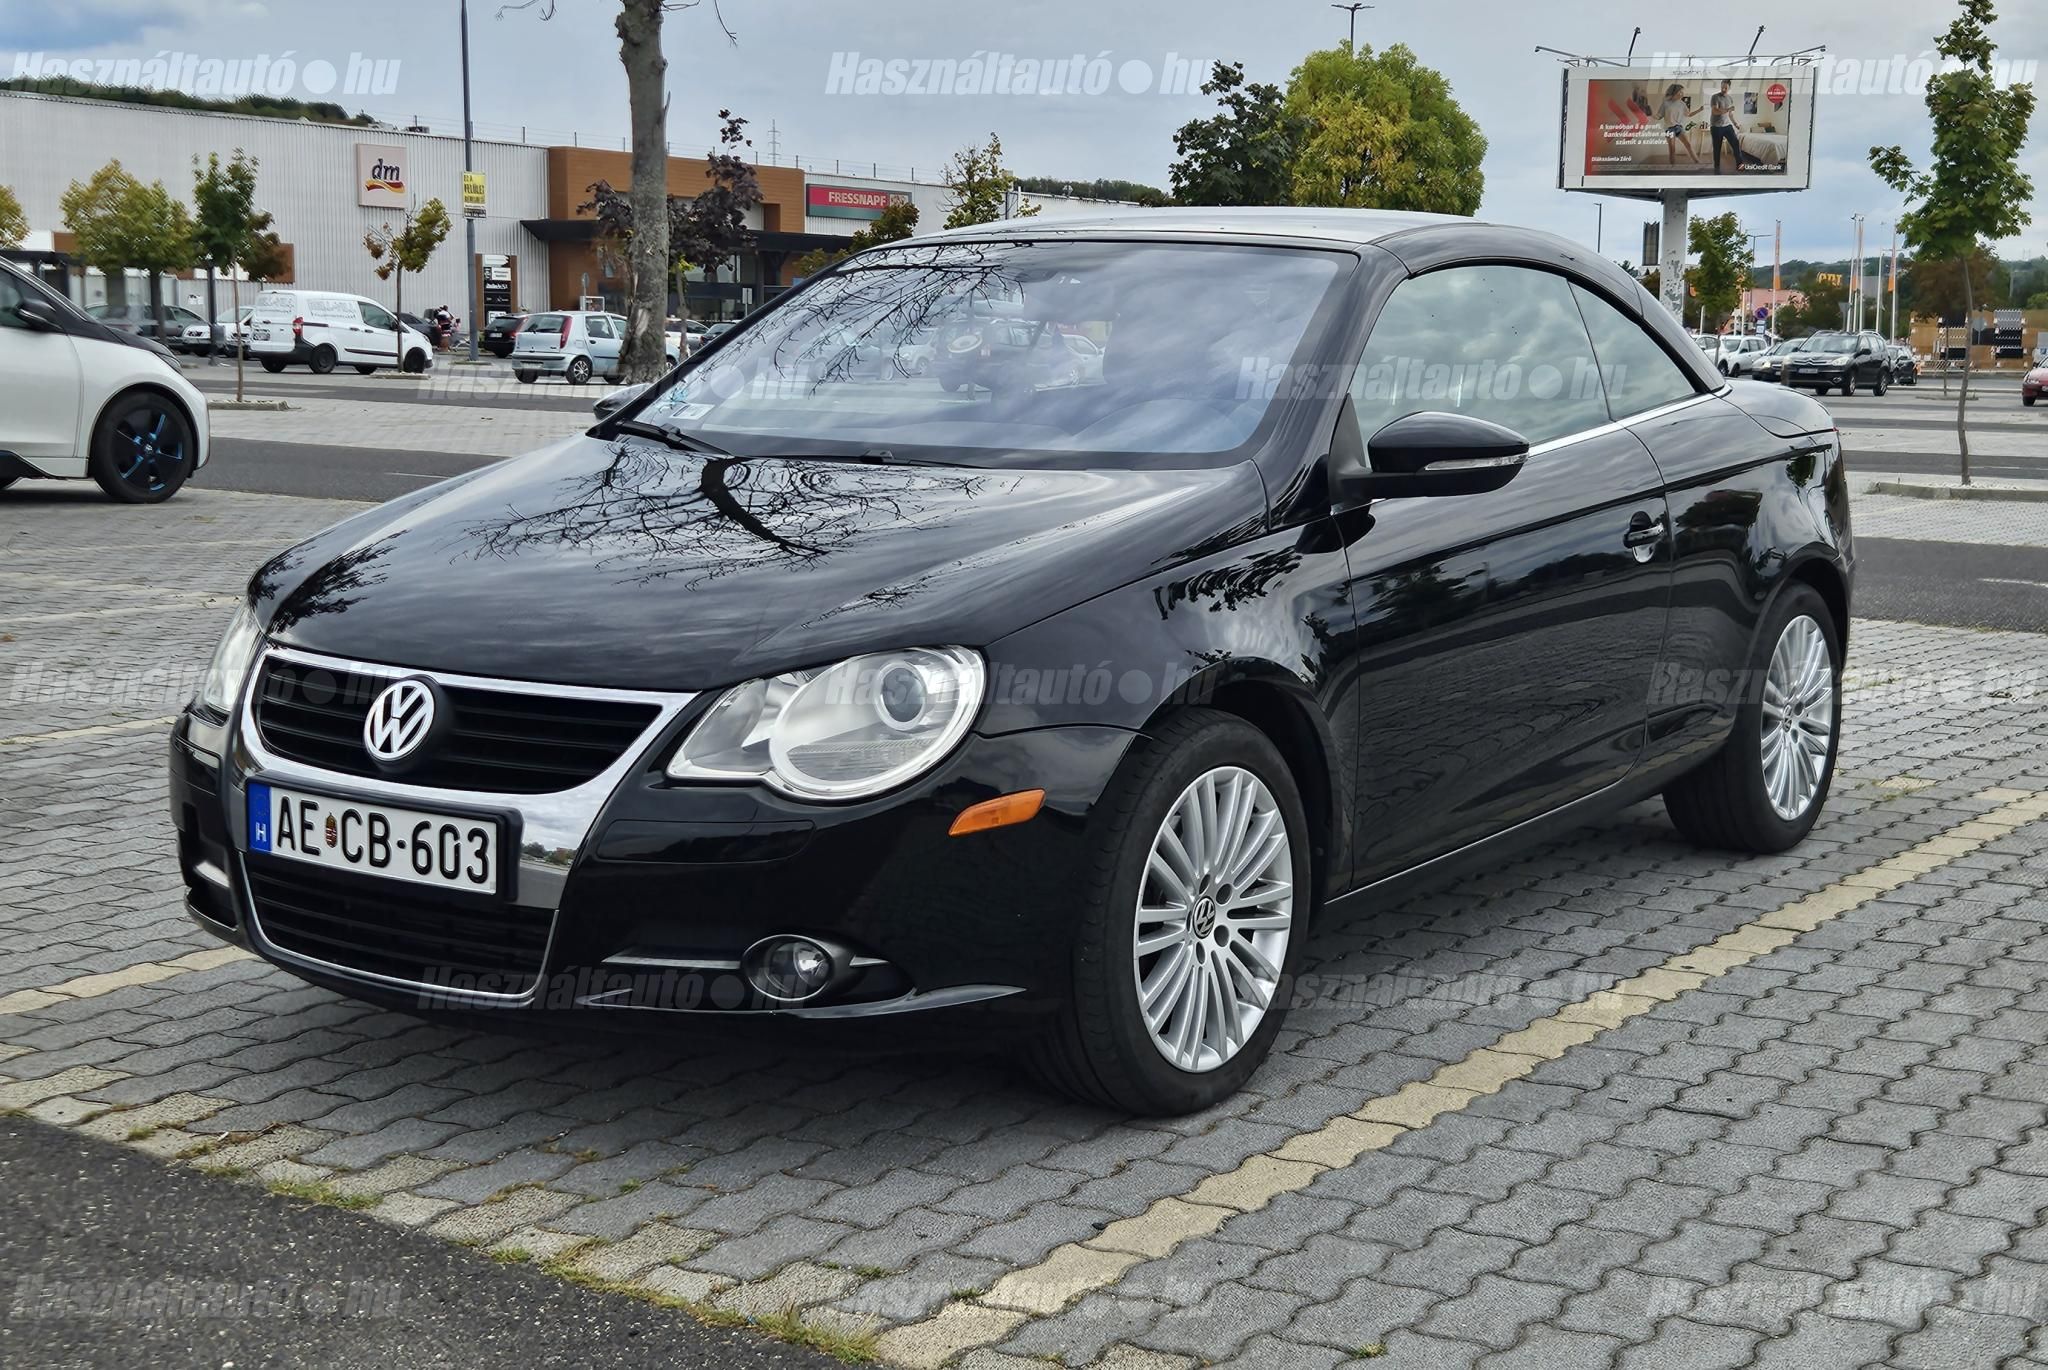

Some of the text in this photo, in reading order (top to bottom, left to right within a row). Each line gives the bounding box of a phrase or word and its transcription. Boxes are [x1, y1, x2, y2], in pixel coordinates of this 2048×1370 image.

[372, 158, 400, 180] dm
[828, 191, 887, 206] FRESSNAPF
[255, 822, 266, 842] H
[276, 795, 320, 856] AE
